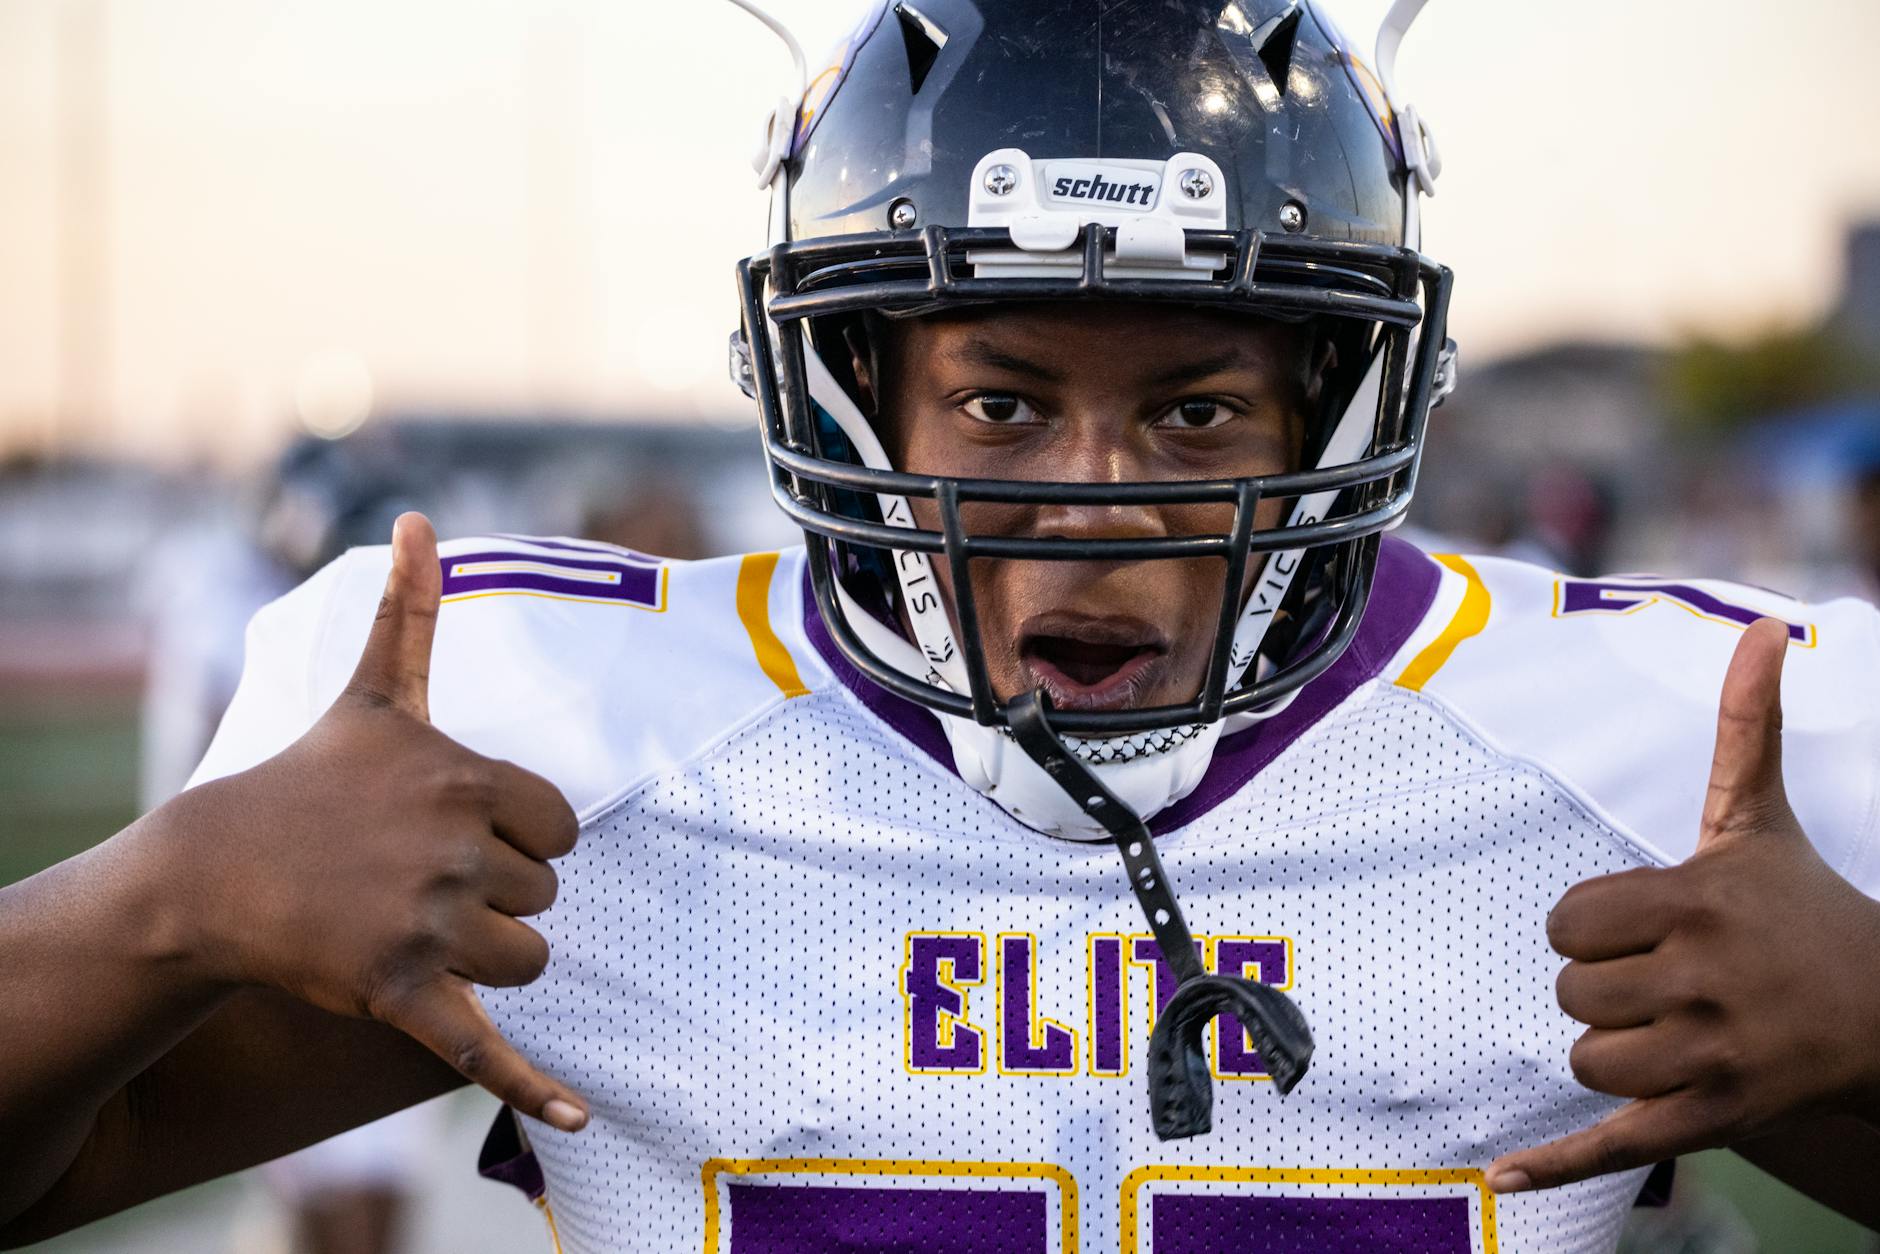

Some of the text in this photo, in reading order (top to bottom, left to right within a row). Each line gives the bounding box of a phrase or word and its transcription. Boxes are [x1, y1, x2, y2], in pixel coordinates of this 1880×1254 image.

[1053, 174, 1154, 205] schutt
[886, 499, 938, 614] VCIS
[1250, 510, 1317, 616] VICS
